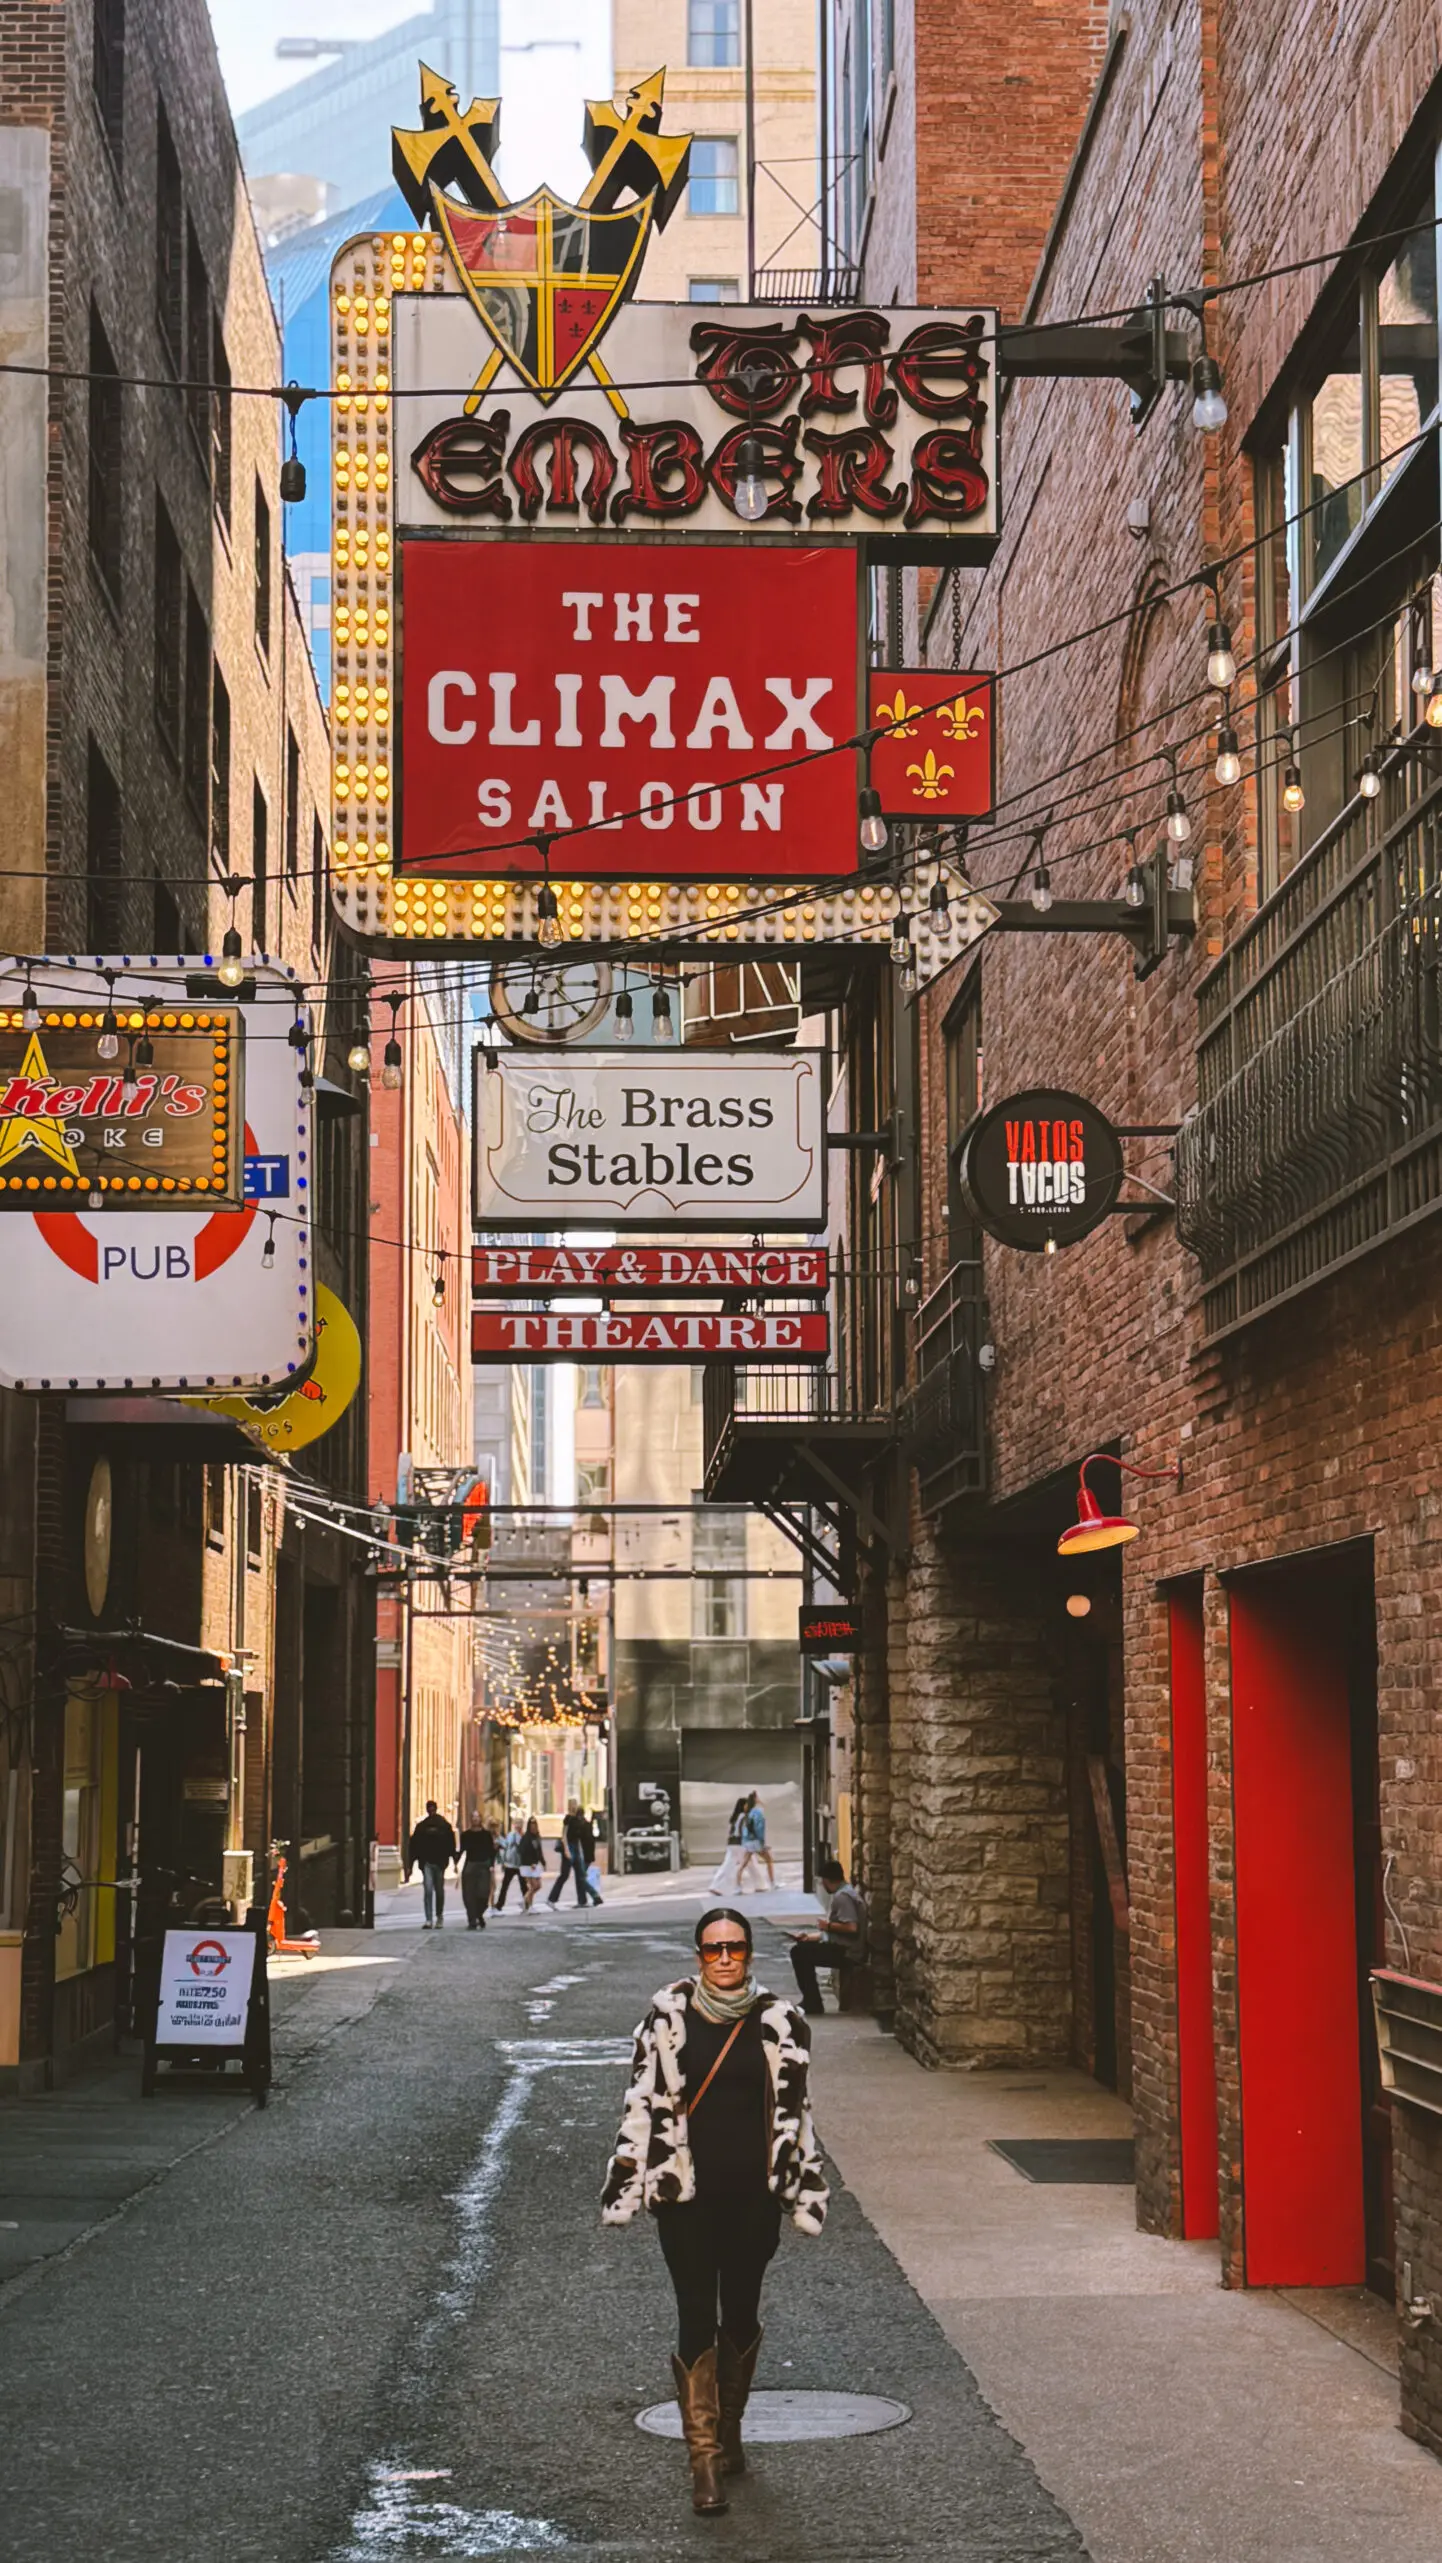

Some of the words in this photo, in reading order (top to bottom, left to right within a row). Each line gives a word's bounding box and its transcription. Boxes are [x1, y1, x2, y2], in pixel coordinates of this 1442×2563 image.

[410, 403, 988, 529] EMBERS
[562, 592, 700, 643] THE
[427, 671, 834, 751] CLIMAX
[477, 779, 785, 832] SALOON
[0, 1075, 208, 1118] Kelli's
[526, 1085, 606, 1133] The
[621, 1088, 774, 1128] Brass
[1005, 1120, 1084, 1161] VATOS
[548, 1143, 755, 1186] Stables
[104, 1246, 190, 1279] PUB
[485, 1251, 605, 1284] PLAY
[614, 1251, 647, 1285] &
[658, 1251, 817, 1285] DANCE
[501, 1317, 802, 1349] THEATRE
